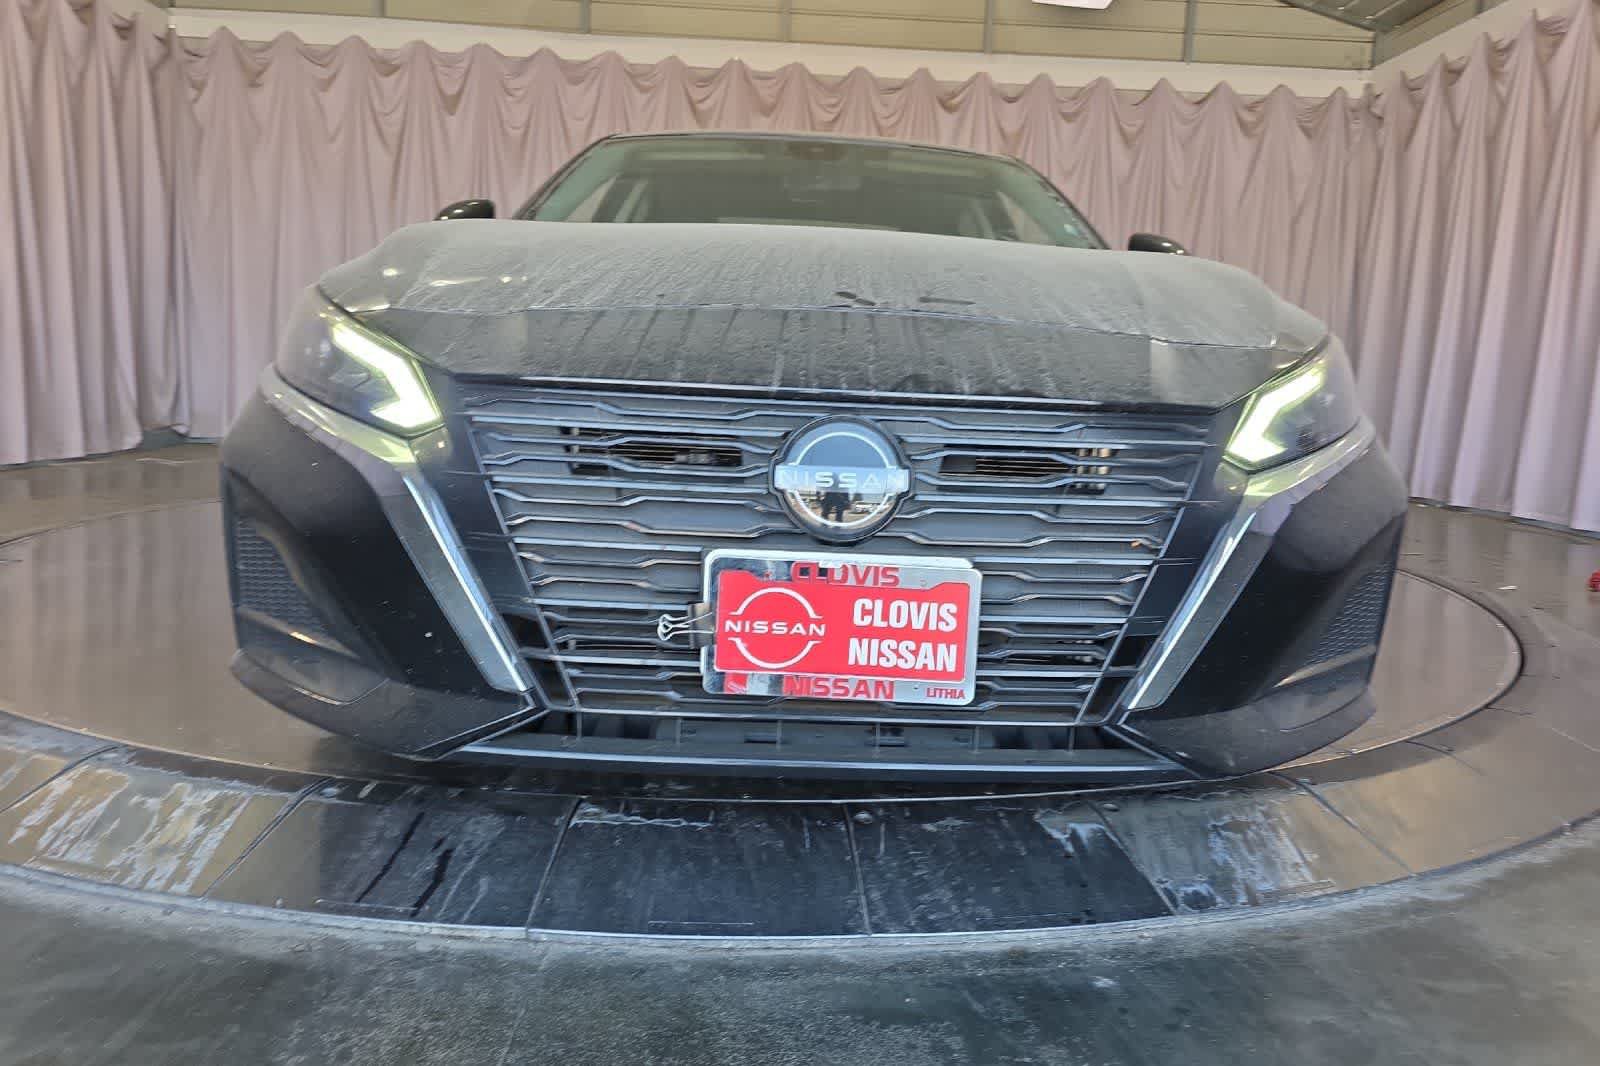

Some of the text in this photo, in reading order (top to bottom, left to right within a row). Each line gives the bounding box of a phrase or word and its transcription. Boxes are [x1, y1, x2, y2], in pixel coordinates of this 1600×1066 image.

[779, 470, 905, 490] NISSAN
[853, 598, 958, 632] CLOVIS
[724, 619, 826, 636] NISSAN
[848, 637, 958, 672] NISSAN
[783, 674, 895, 700] NISSAN
[926, 687, 966, 700] LITHIA
